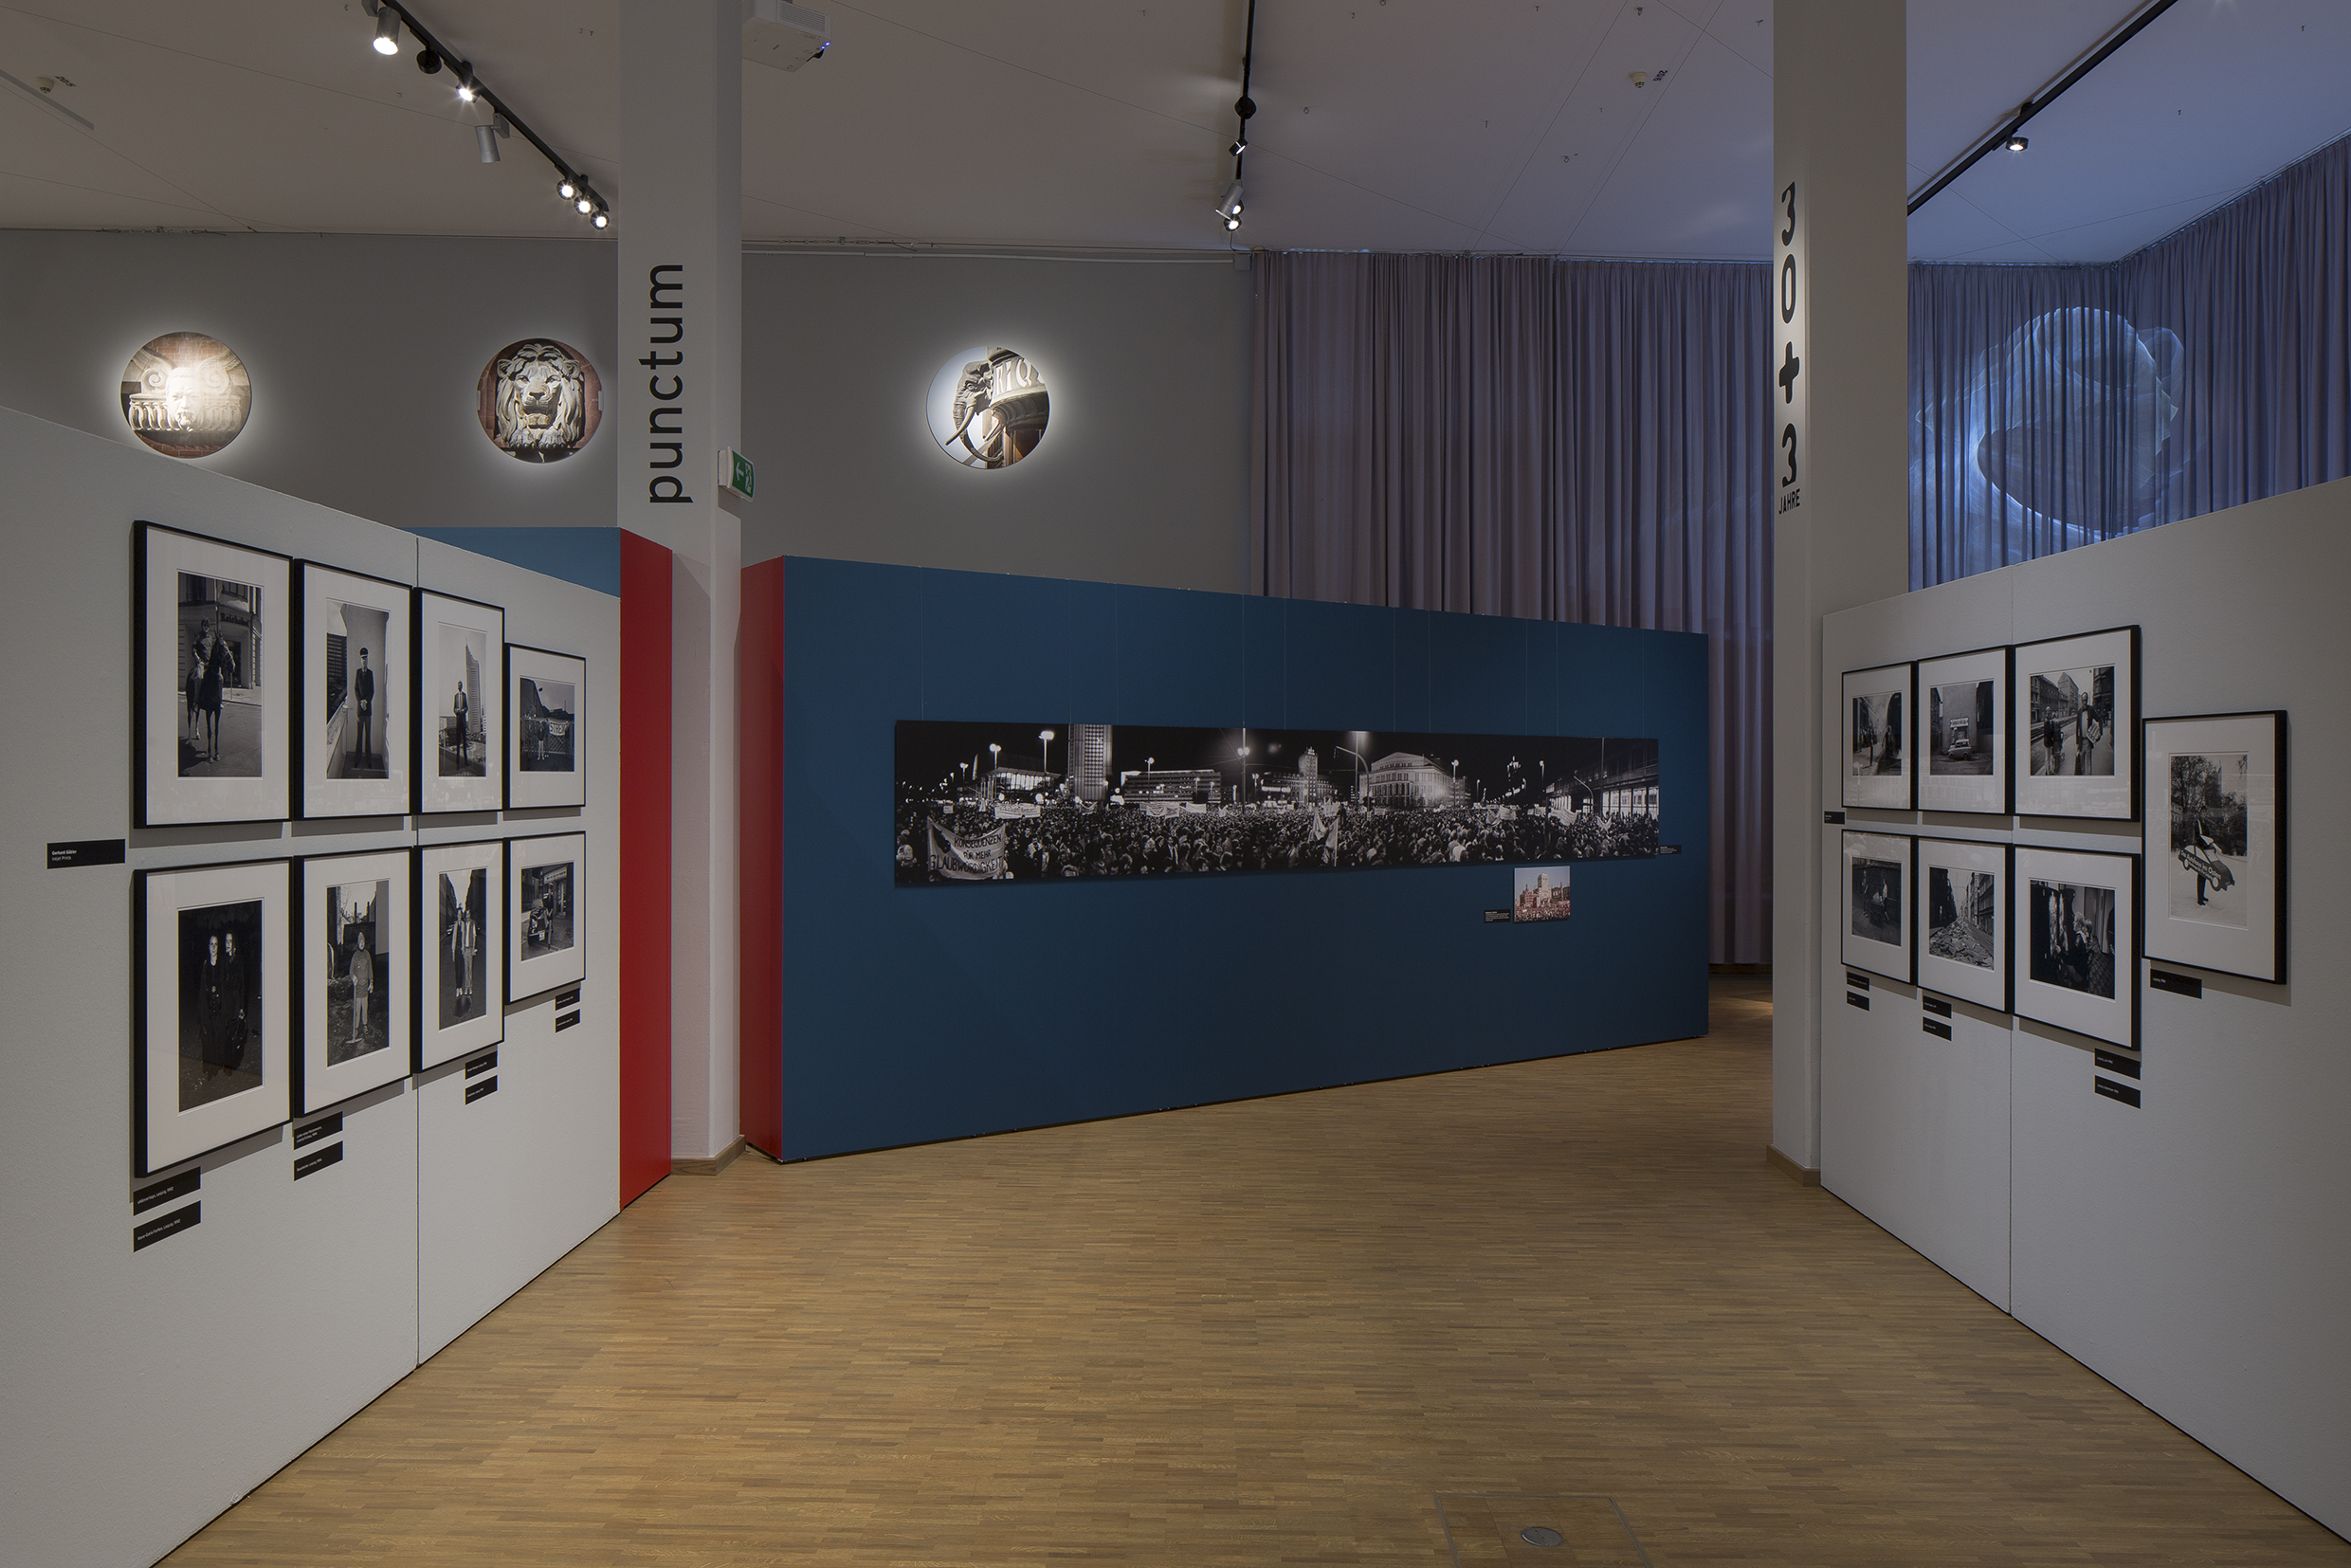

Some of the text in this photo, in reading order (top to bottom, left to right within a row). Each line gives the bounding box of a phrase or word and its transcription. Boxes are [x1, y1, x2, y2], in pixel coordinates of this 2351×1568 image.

[637, 264, 694, 503] punctum
[1777, 487, 1801, 516] JAHRE
[954, 833, 1002, 848] KONSEQUENZEN
[930, 854, 1004, 874] GLAUBWÜRDIGKEIT
[975, 849, 992, 860] MEHR
